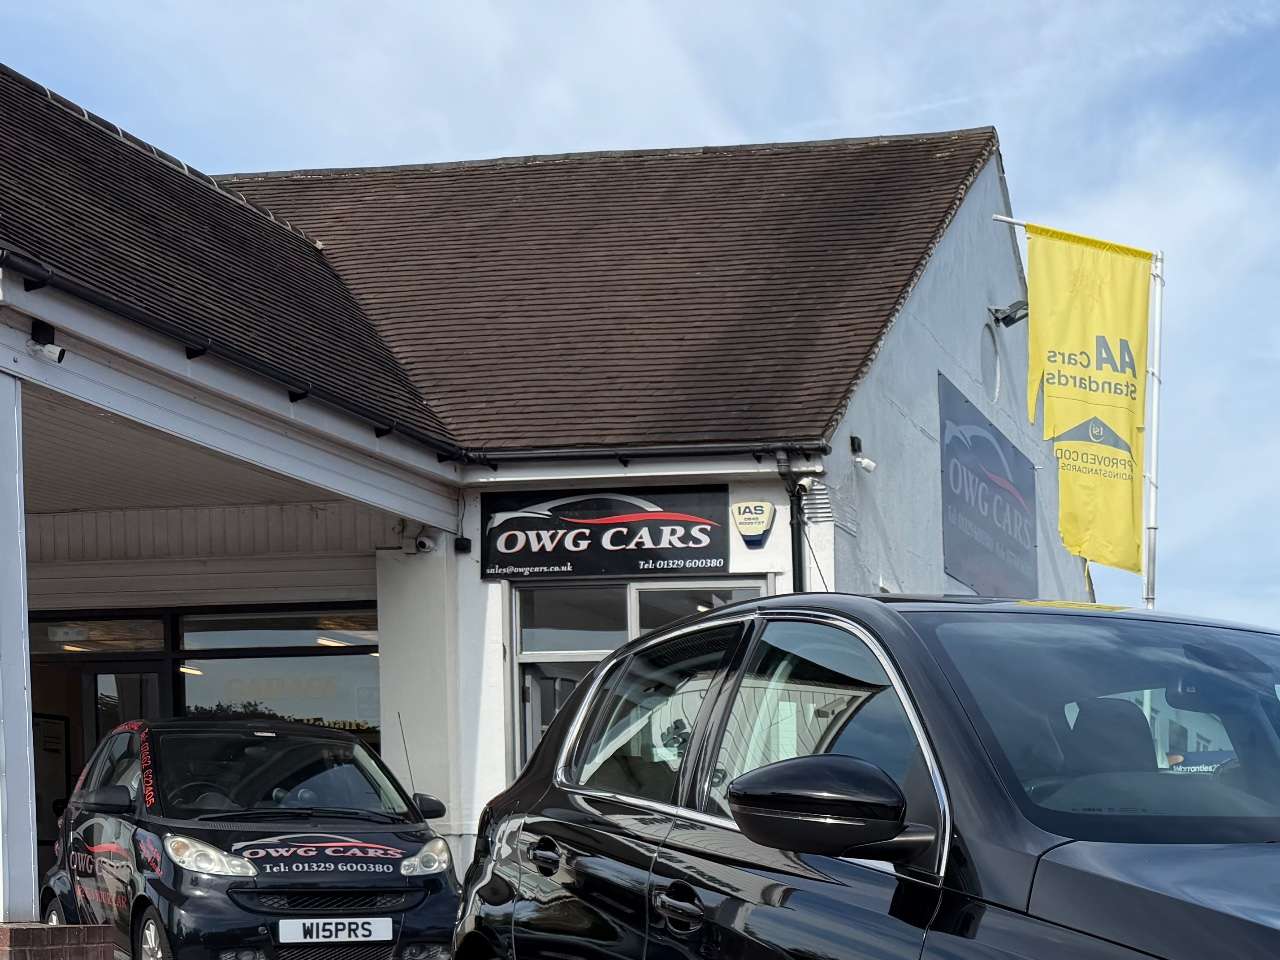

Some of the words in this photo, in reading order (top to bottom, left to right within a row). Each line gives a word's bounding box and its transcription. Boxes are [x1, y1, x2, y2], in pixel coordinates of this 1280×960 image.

[737, 505, 765, 516] IAS
[950, 457, 989, 517] OWG
[993, 495, 1032, 550] CARS
[496, 528, 592, 554] OWG
[601, 524, 712, 550] CARS
[486, 562, 574, 576] sales@owgcars.co.uk
[638, 560, 655, 570] Tel:
[657, 559, 684, 570] 01329
[685, 558, 724, 569] 600380
[242, 847, 318, 859] OWG
[324, 847, 404, 859] CARS
[263, 862, 289, 874] Tel:
[292, 862, 335, 873] 01329
[338, 862, 394, 874] 600380
[302, 921, 373, 940] W15PRS
